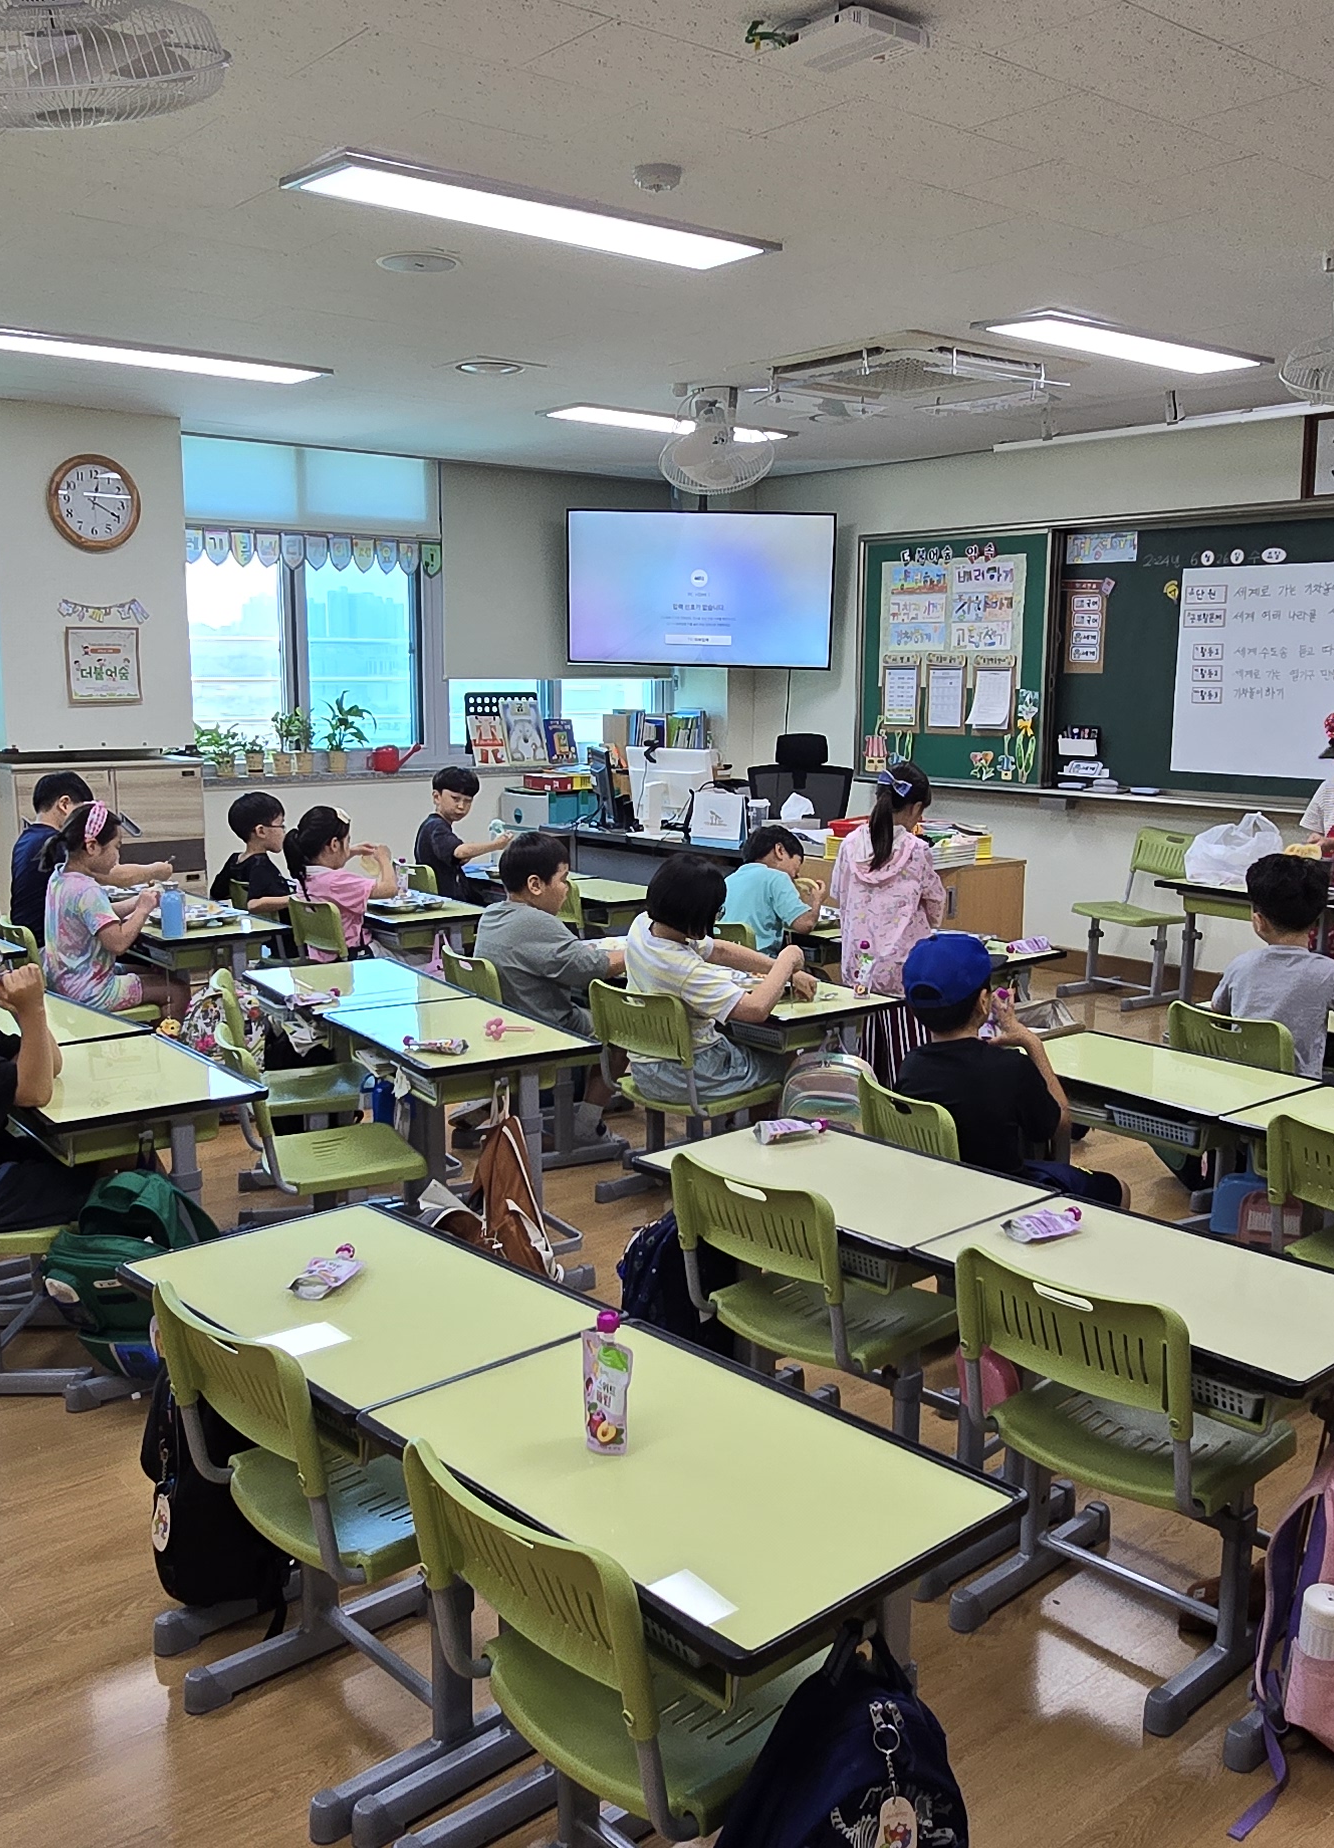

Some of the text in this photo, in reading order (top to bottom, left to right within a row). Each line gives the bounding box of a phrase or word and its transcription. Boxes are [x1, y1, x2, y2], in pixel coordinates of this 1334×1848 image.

[76, 471, 83, 481] 11
[89, 469, 99, 480] 12
[63, 494, 70, 504] 9
[117, 501, 125, 510] 3
[66, 508, 73, 518] 8
[77, 520, 83, 530] 7
[105, 523, 112, 534] 5
[91, 526, 98, 535] 6
